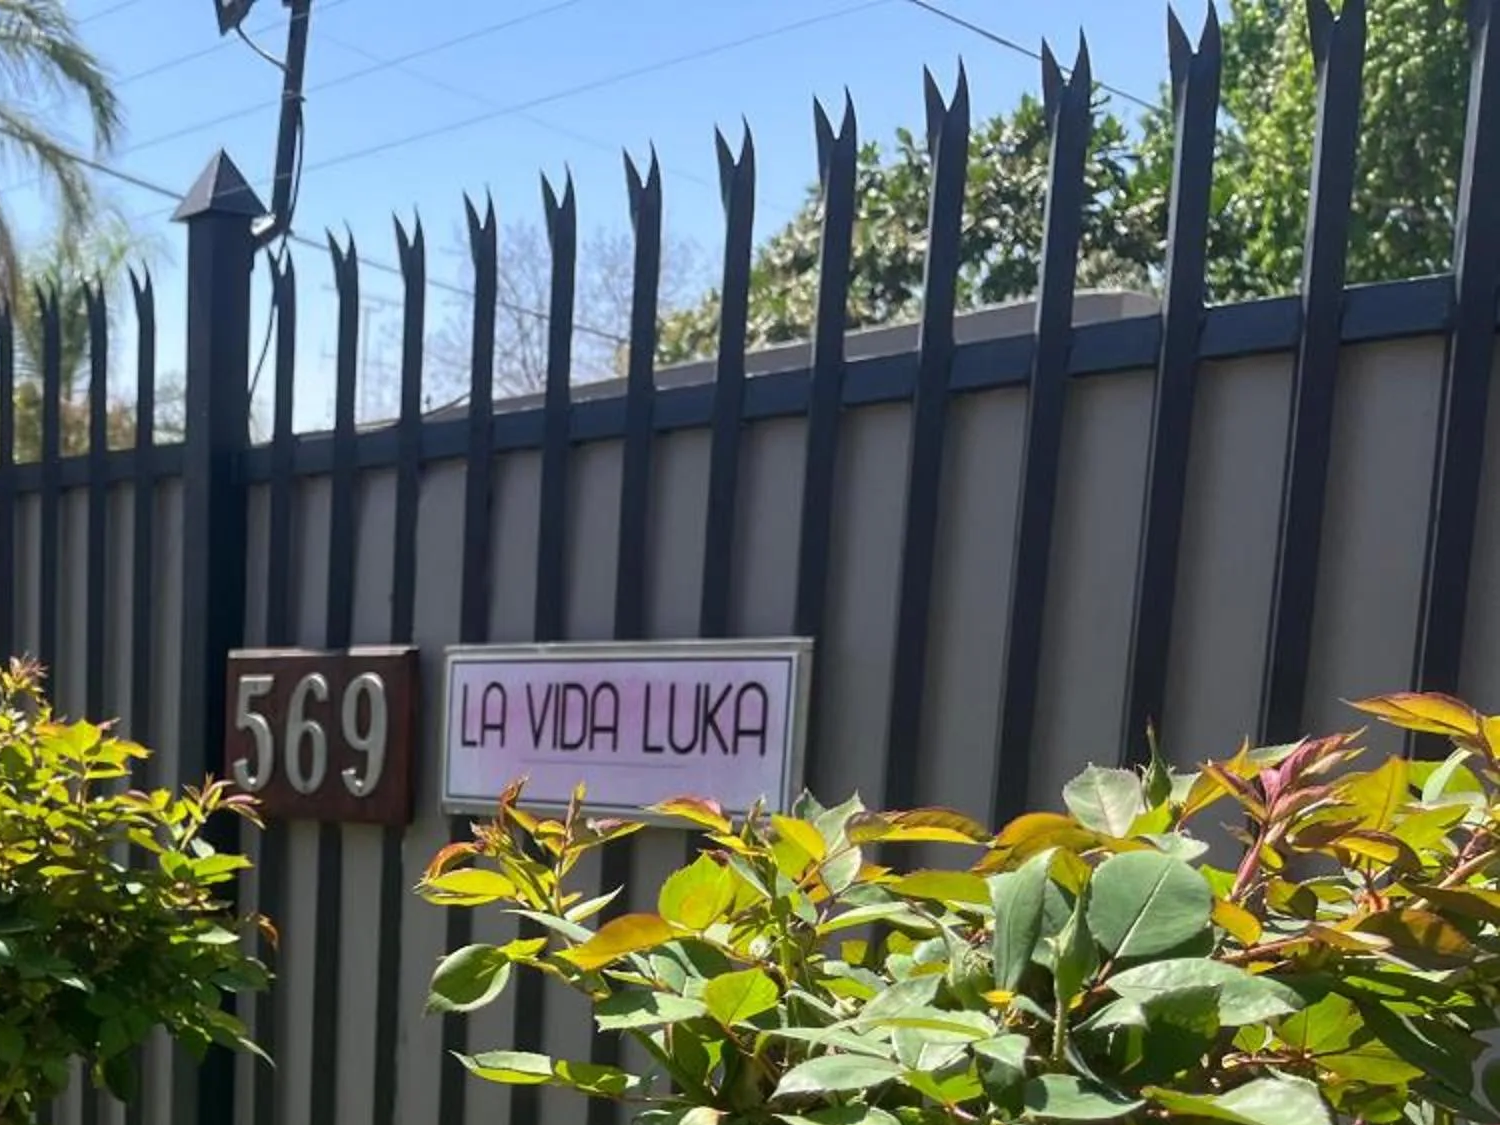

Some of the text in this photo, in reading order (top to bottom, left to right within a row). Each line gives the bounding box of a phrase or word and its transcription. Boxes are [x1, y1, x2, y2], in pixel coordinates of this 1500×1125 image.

[233, 672, 387, 796] 569
[461, 682, 768, 755] LA VIDA LUKA
